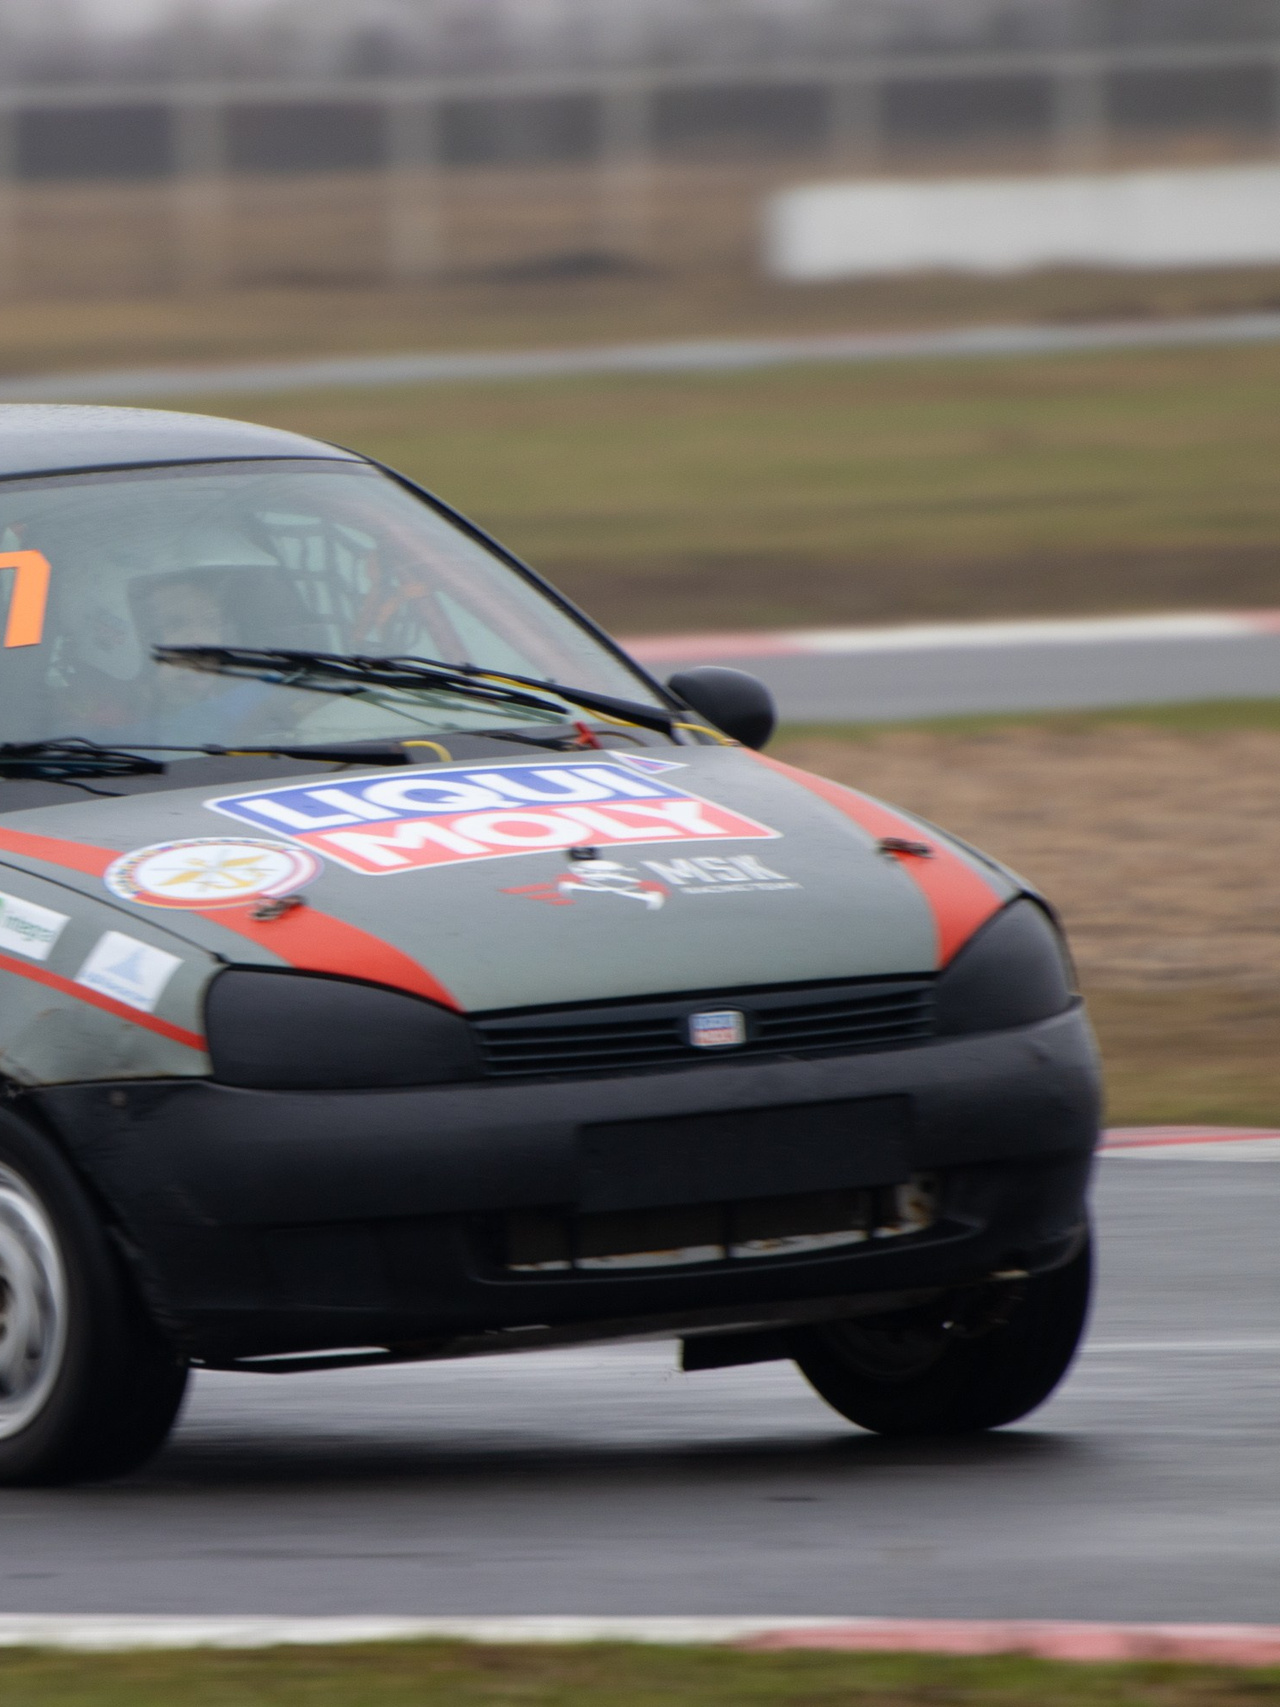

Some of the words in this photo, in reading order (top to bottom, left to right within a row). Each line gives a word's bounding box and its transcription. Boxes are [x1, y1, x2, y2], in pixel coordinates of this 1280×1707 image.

[236, 767, 669, 831] LIQUI
[320, 800, 730, 869] MOLY
[640, 854, 791, 886] MSK
